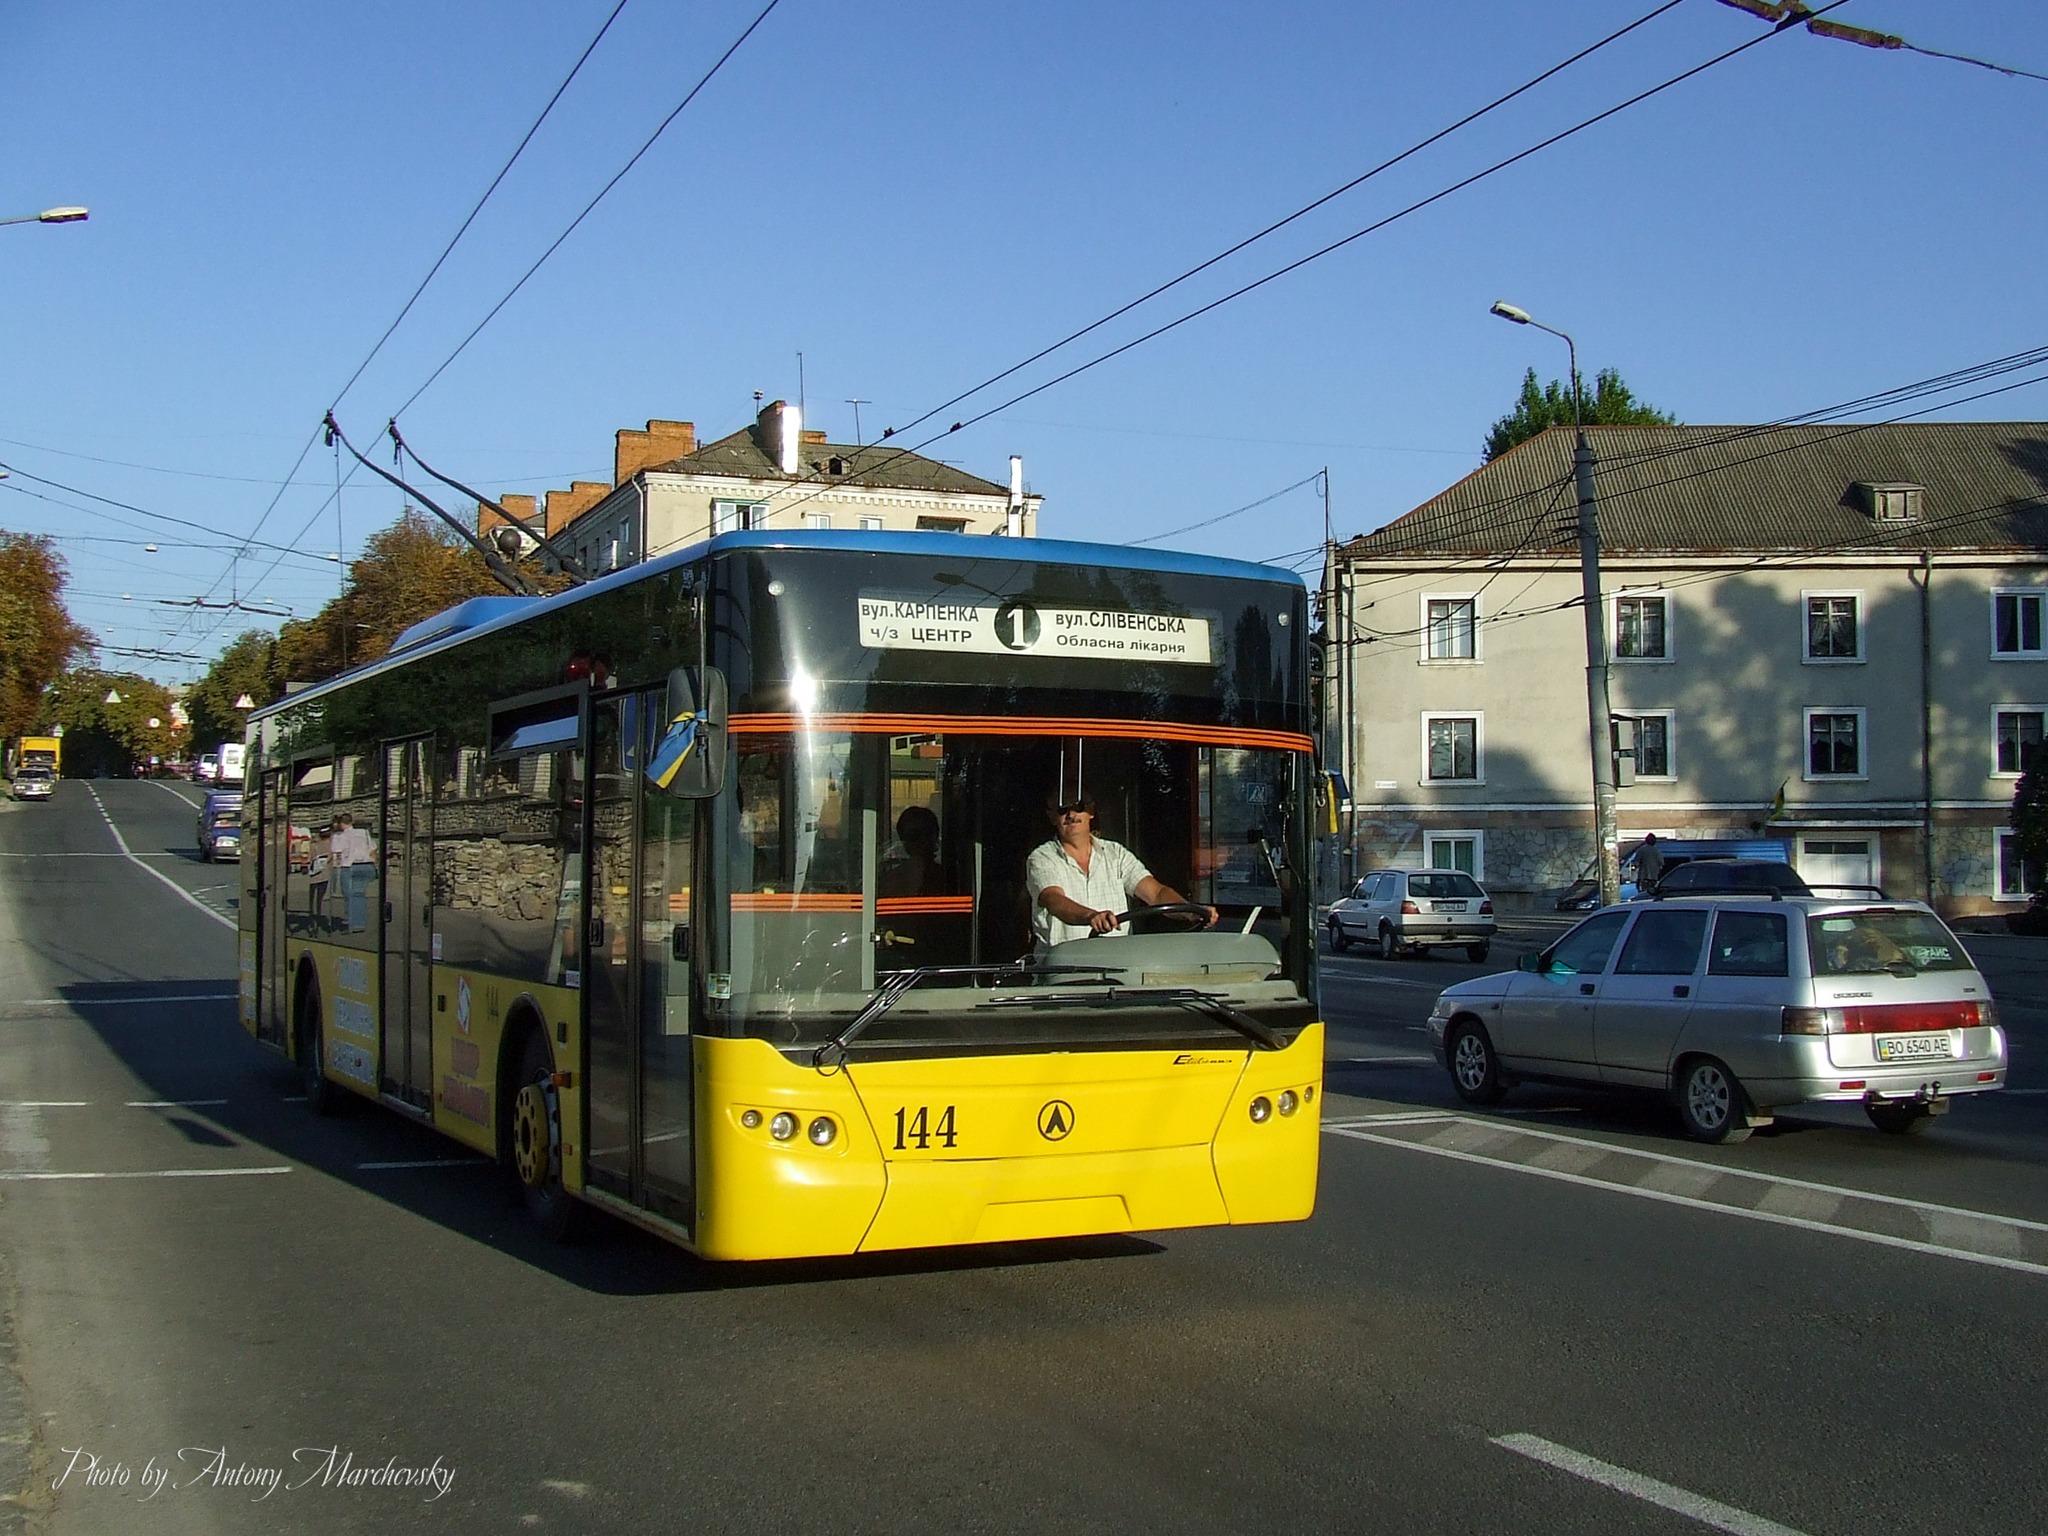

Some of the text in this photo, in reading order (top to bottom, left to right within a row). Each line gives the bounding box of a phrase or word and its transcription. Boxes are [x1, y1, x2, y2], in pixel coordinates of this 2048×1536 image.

[861, 602, 980, 622] вул.КАРПЕНКА
[1055, 611, 1187, 634] вул.СЛІВЕНСЬКА
[911, 627, 973, 643] ЦЕНТР
[1006, 607, 1028, 648] 1
[1056, 634, 1186, 655] Обласна лікарня
[1906, 1039, 1932, 1054] 6540
[892, 1105, 958, 1151] 144
